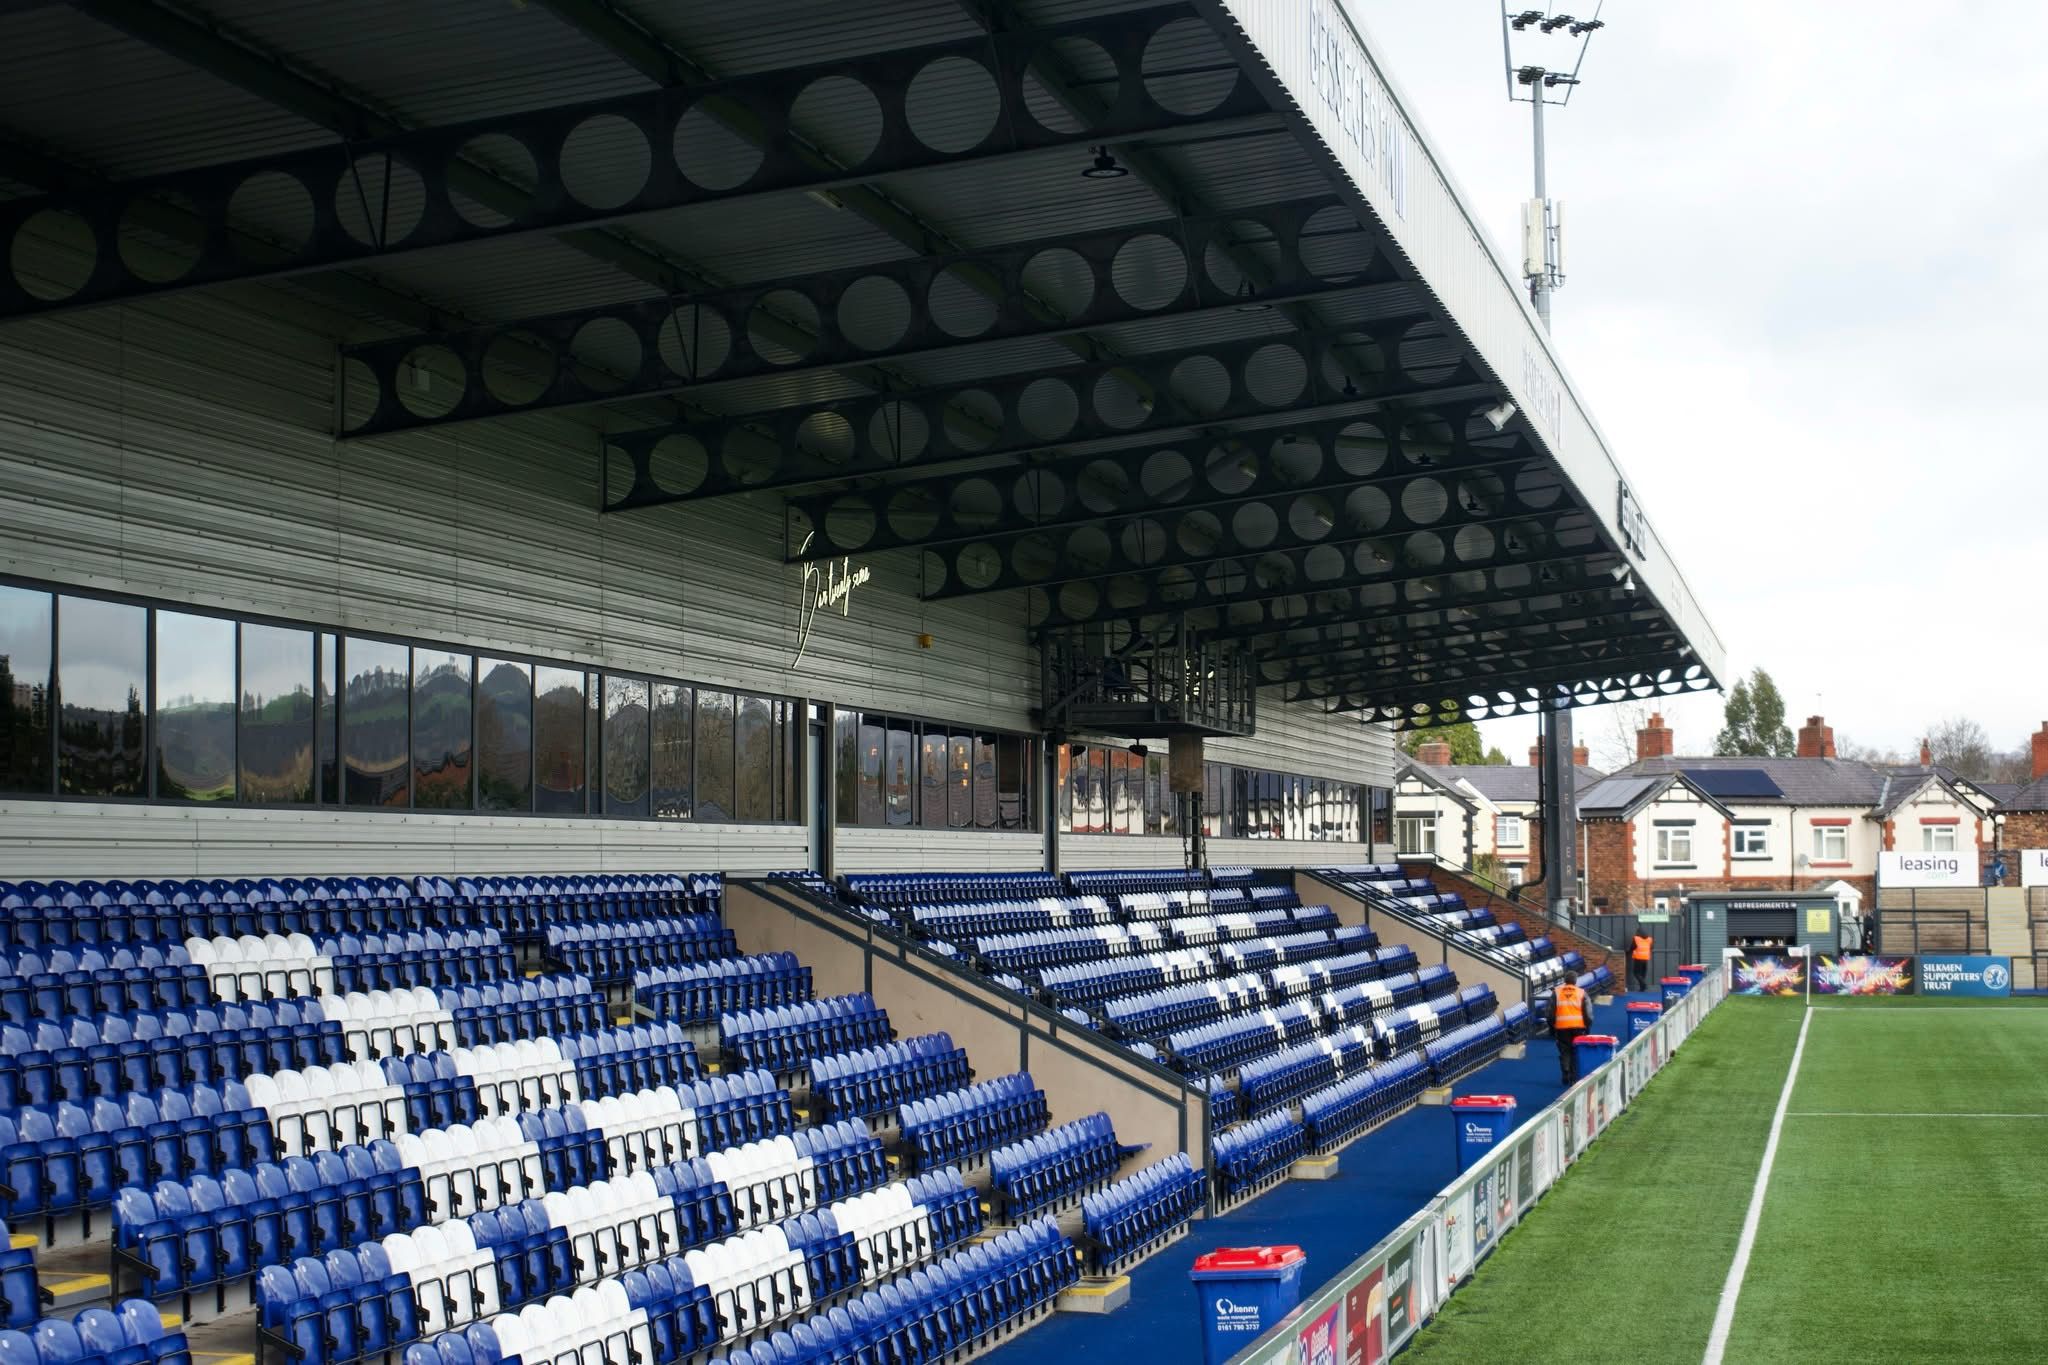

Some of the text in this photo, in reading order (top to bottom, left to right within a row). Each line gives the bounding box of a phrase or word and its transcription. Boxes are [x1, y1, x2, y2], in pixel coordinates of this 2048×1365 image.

[1900, 855, 1958, 873] leasing
[1923, 963, 1962, 972] SILKMEN
[1923, 981, 1952, 990] TRUST
[1234, 1304, 1258, 1314] kenny
